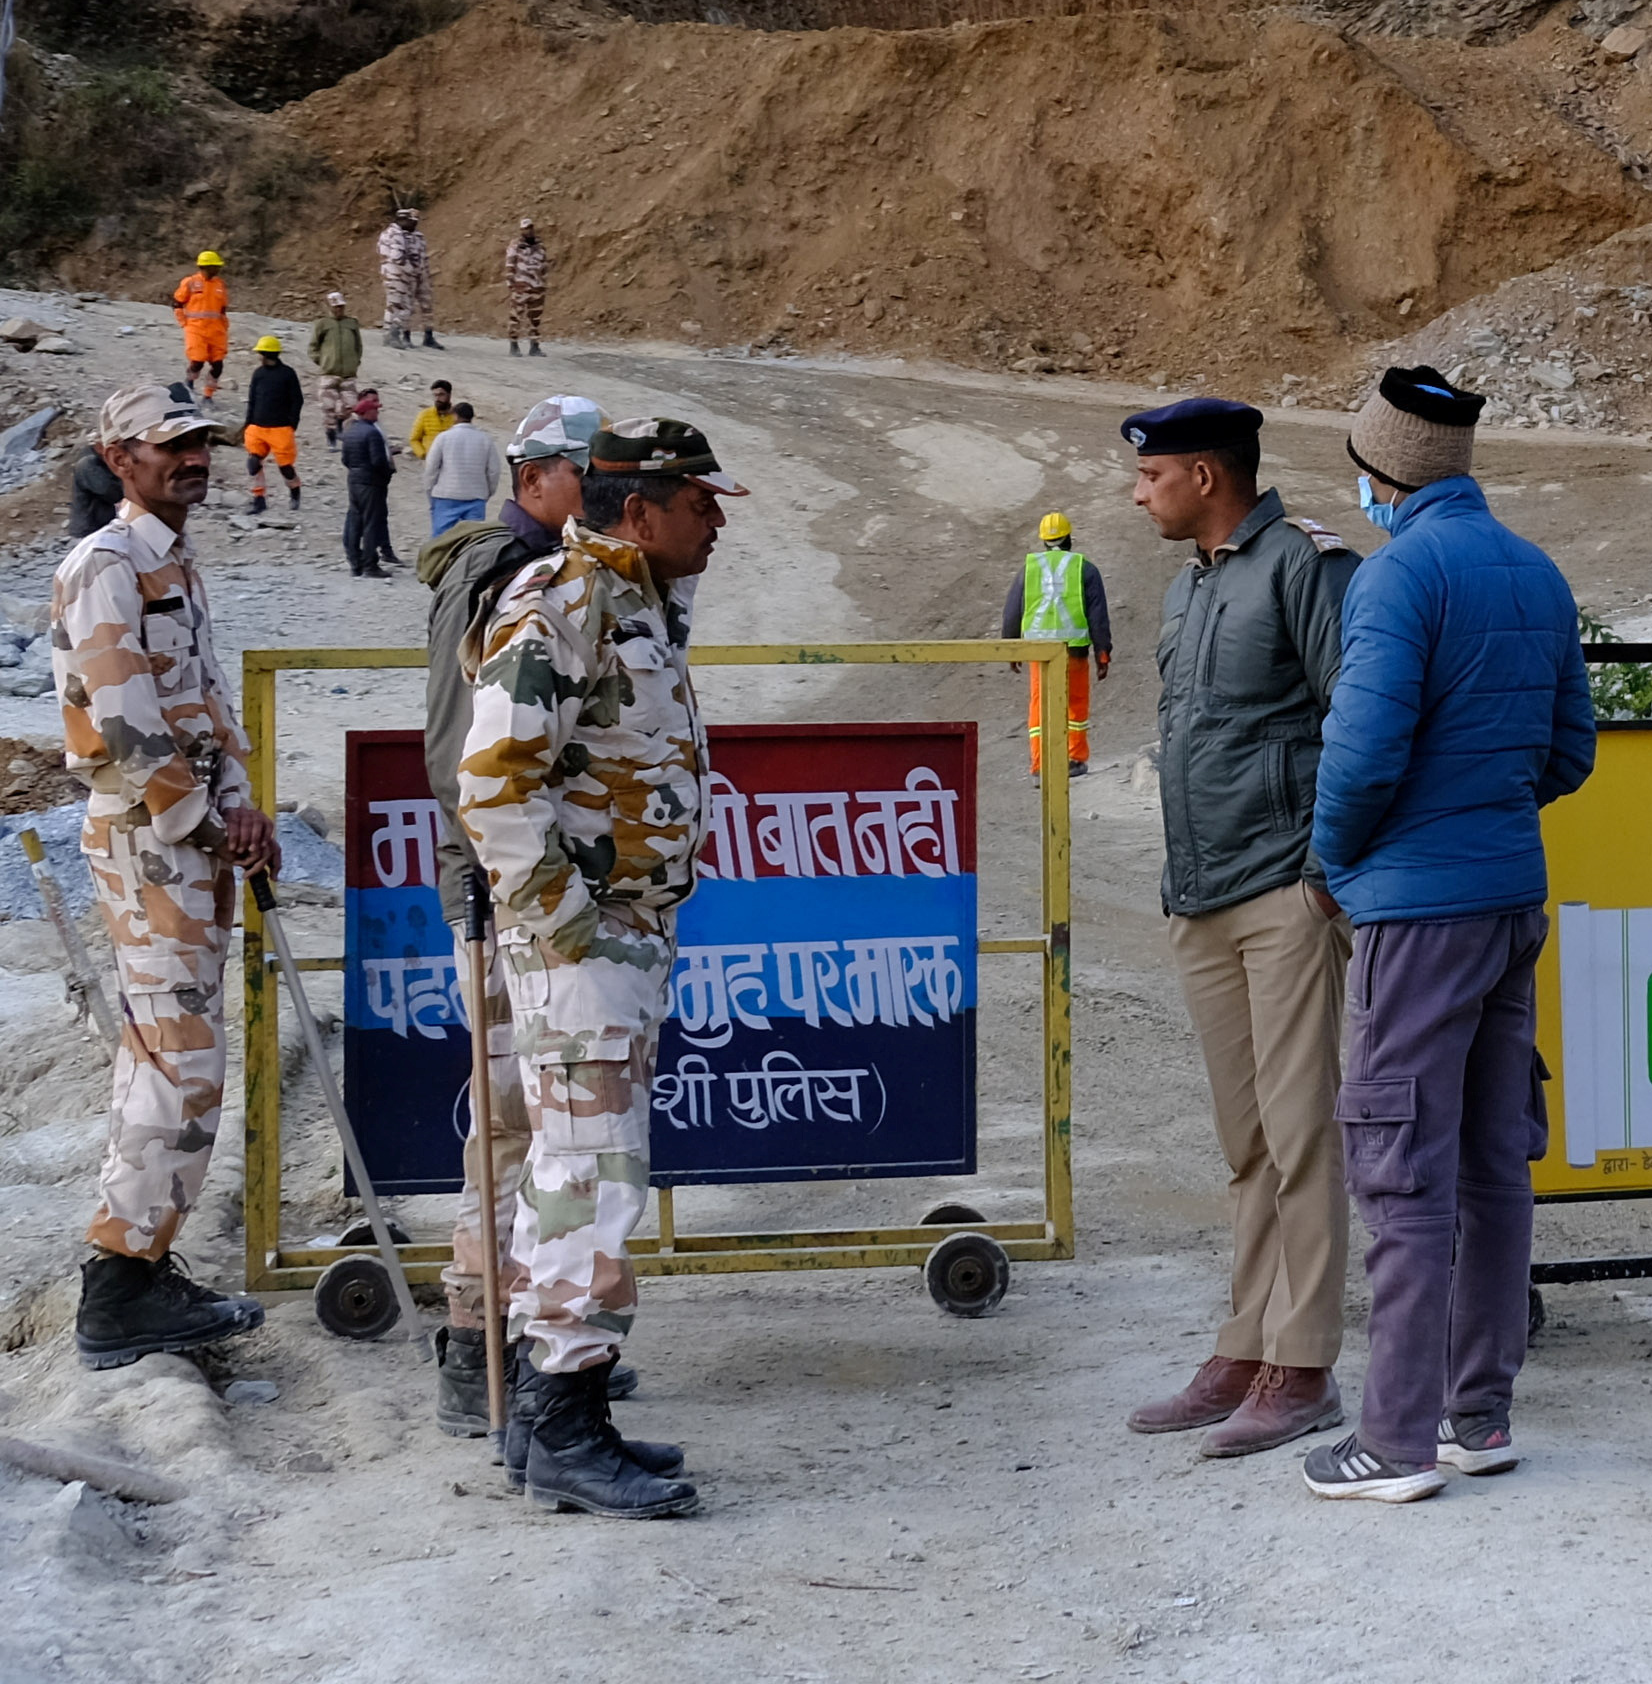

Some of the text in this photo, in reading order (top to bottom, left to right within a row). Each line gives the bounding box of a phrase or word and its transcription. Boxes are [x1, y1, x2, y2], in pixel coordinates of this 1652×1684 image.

[754, 791, 855, 879] बात
[854, 766, 961, 878] नही
[772, 940, 854, 1030] पर
